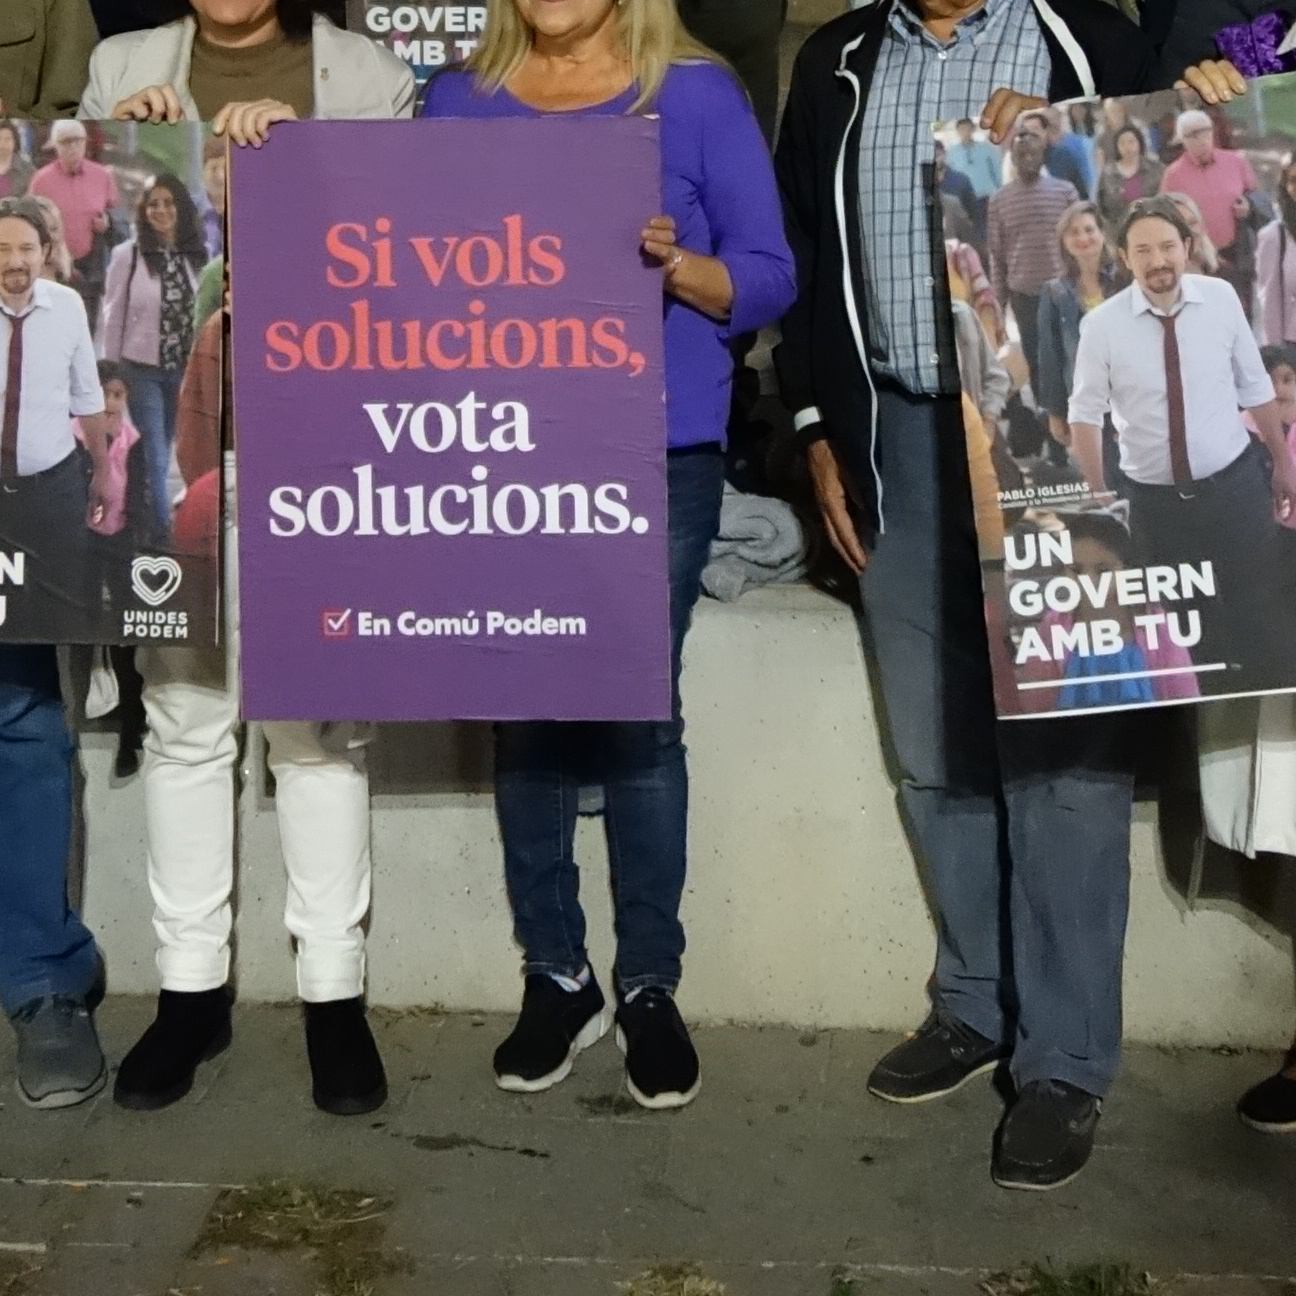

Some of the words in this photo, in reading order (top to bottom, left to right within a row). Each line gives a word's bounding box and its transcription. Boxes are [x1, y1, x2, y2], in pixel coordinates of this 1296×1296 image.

[365, 6, 488, 33] GOVER
[376, 39, 446, 66] MB
[326, 218, 397, 288] Si
[410, 215, 565, 287] vols
[265, 300, 646, 376] solucions,
[362, 391, 537, 453] vota
[269, 464, 650, 537] solucions.
[996, 488, 1035, 502] PABLO
[1037, 482, 1090, 497] IGLESIAS
[1003, 530, 1074, 570] UN
[1009, 561, 1216, 616] GOVERN
[123, 610, 188, 625] UNIDES
[123, 624, 188, 639] PODEM
[357, 611, 391, 636] En
[396, 609, 480, 636] Comú
[486, 608, 587, 636] Podem
[1014, 618, 1124, 665] AMB
[1134, 609, 1202, 650] TU
